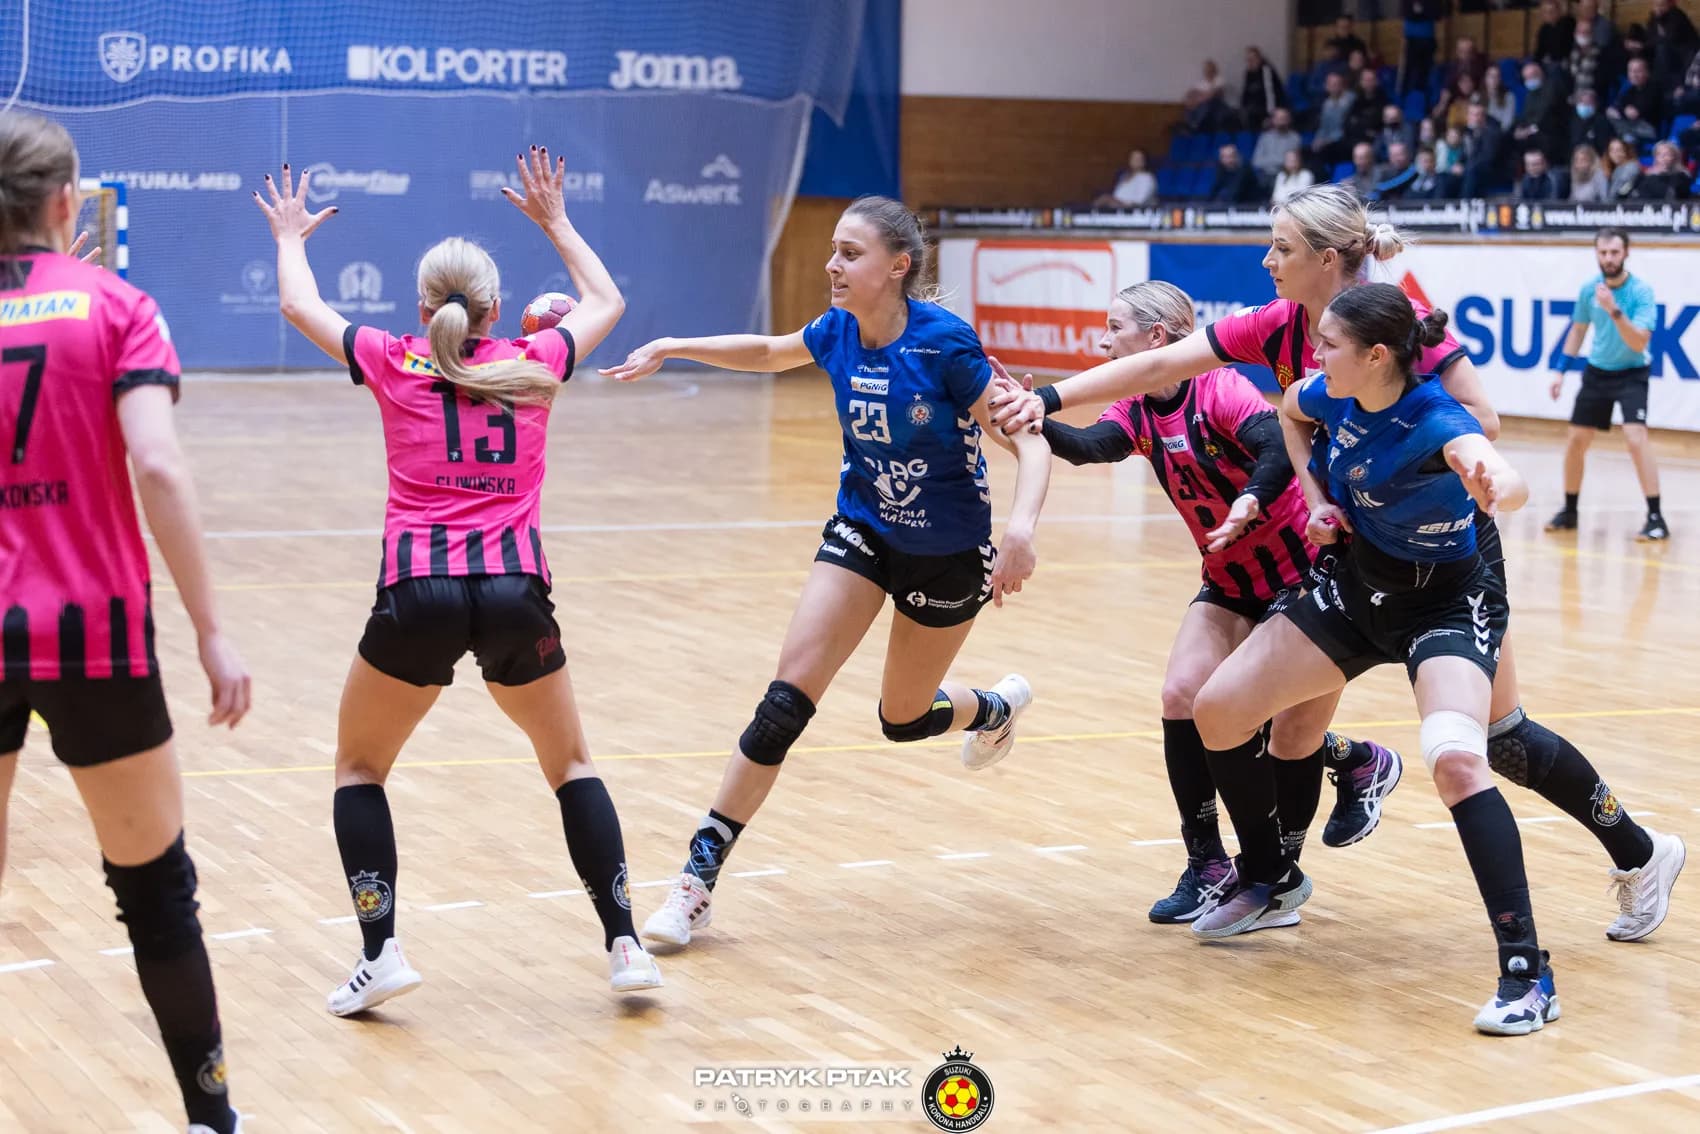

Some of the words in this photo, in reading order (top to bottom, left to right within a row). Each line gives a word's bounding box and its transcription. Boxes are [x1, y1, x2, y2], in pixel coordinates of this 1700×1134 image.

[149, 46, 293, 74] PROFIKA
[372, 47, 567, 86] KOLPORTER
[2, 345, 46, 464] 7
[849, 400, 892, 444] 23
